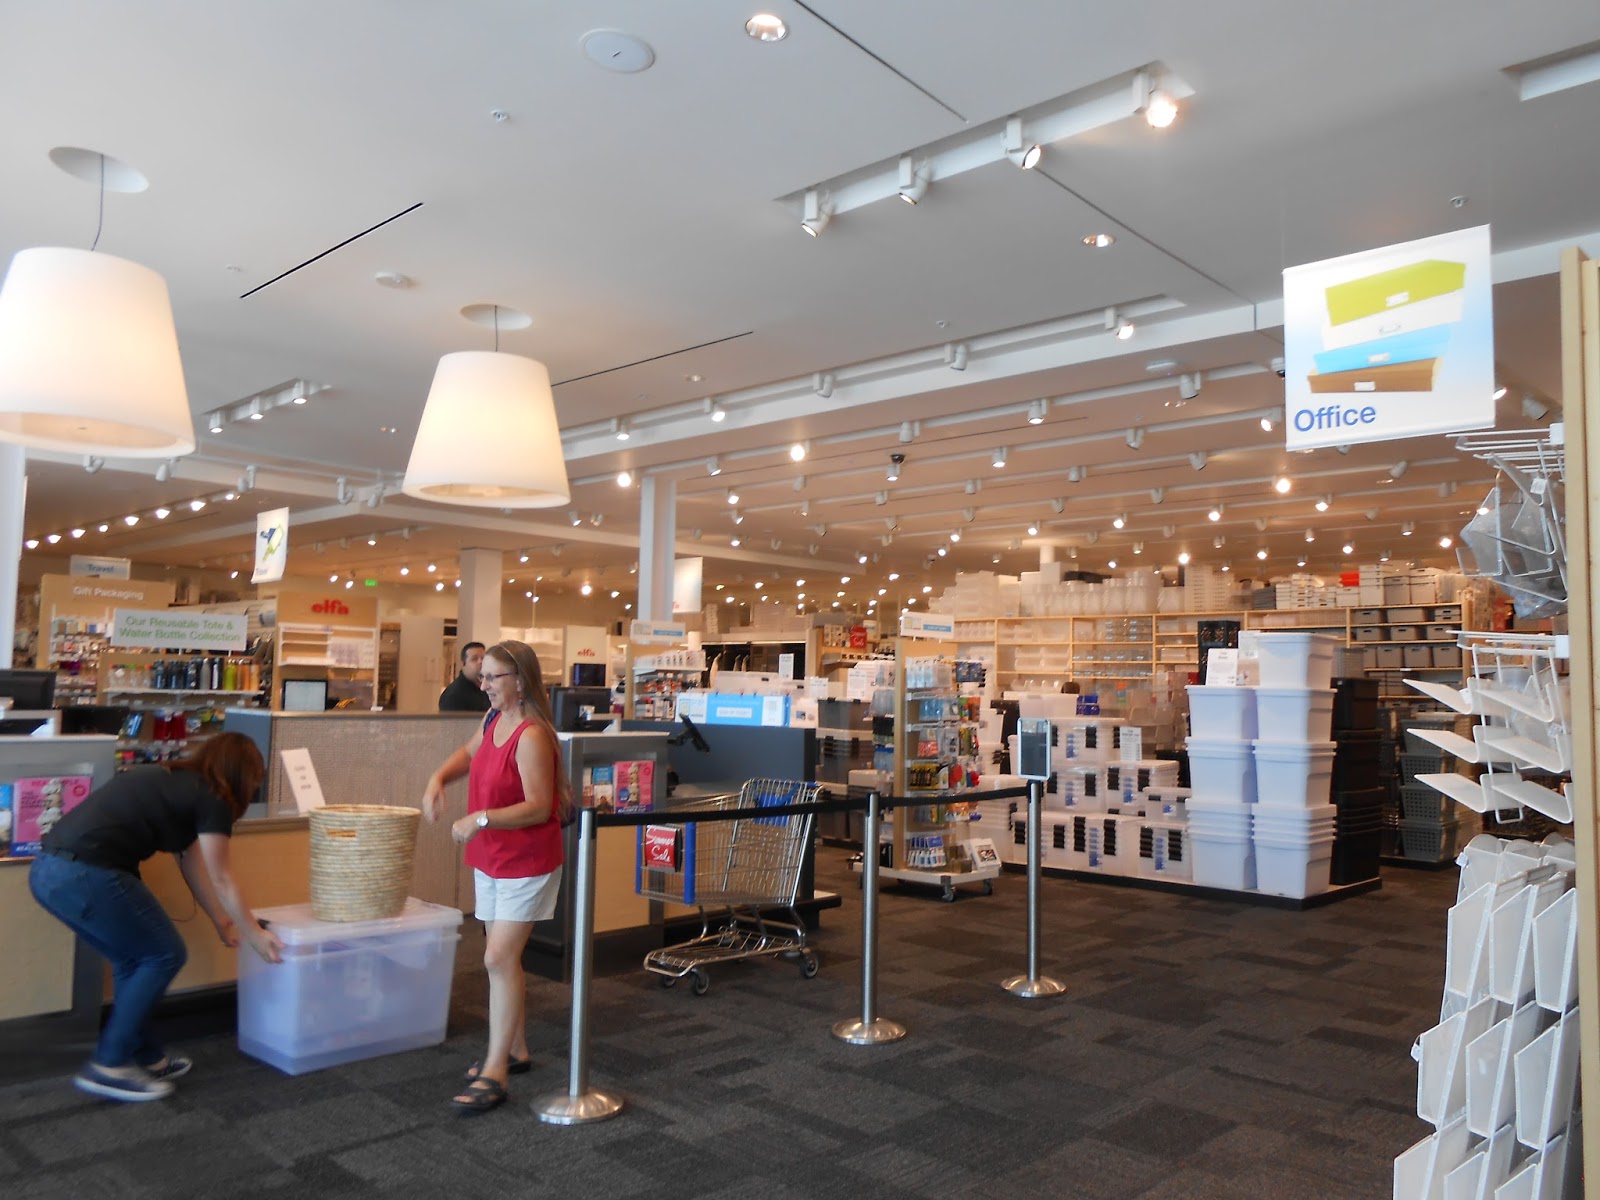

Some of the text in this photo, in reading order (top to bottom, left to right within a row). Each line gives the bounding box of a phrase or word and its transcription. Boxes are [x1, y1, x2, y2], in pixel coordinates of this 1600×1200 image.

[1294, 405, 1376, 432] Office
[87, 563, 115, 573] Travel
[73, 586, 145, 601] Gift Packaging
[311, 599, 350, 615] elfa
[125, 616, 234, 630] Our Reusable Tote &
[119, 627, 241, 642] Water Bottle Collection
[577, 648, 596, 657] elfa
[651, 846, 671, 863] Sale
